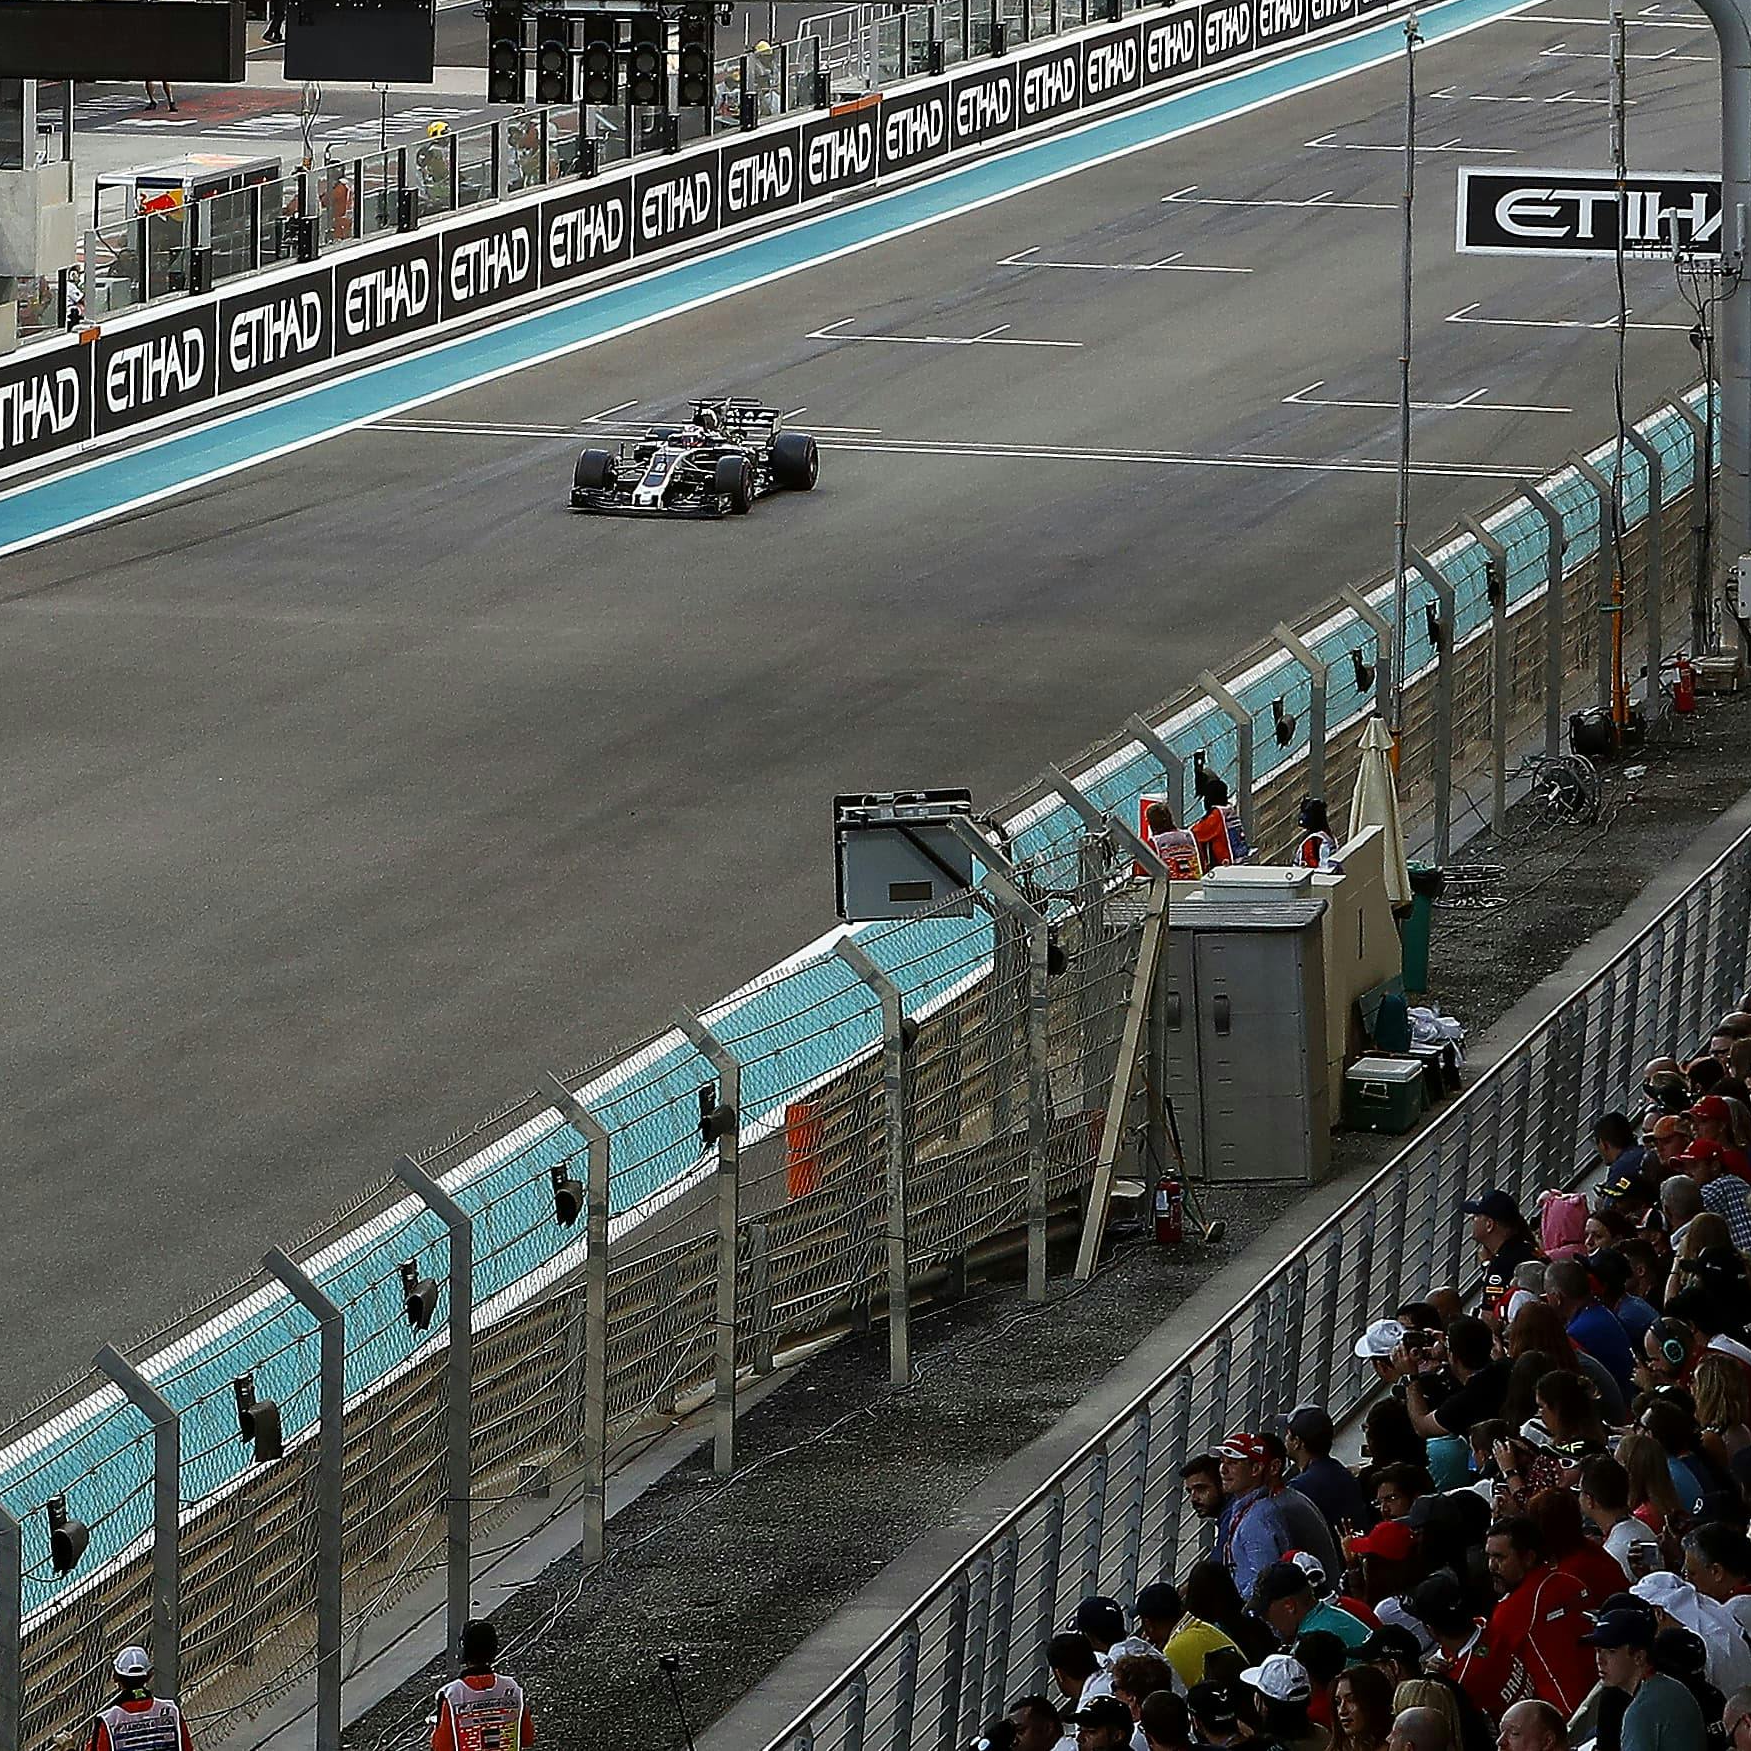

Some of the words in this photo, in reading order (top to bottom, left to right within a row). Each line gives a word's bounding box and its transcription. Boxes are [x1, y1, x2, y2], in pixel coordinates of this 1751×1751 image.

[1147, 18, 1195, 73] ETIHAD
[1205, 2, 1250, 55] ETIHAD
[1024, 57, 1076, 115] ETIHAD
[1086, 37, 1137, 93] ETIHAD
[885, 99, 944, 160] ETIHAD
[956, 77, 1012, 136] ETIHAD
[728, 145, 793, 211] ETIHAD
[808, 122, 872, 185] ETIHAD
[549, 198, 624, 270] ETIHAD
[642, 171, 711, 240] ETIHAD
[1495, 188, 1723, 242] ETIH
[450, 226, 530, 301] ETIHAD
[344, 258, 430, 336] ETIHAD
[229, 292, 322, 373] ETIHAD
[106, 327, 205, 413] ETIHAD
